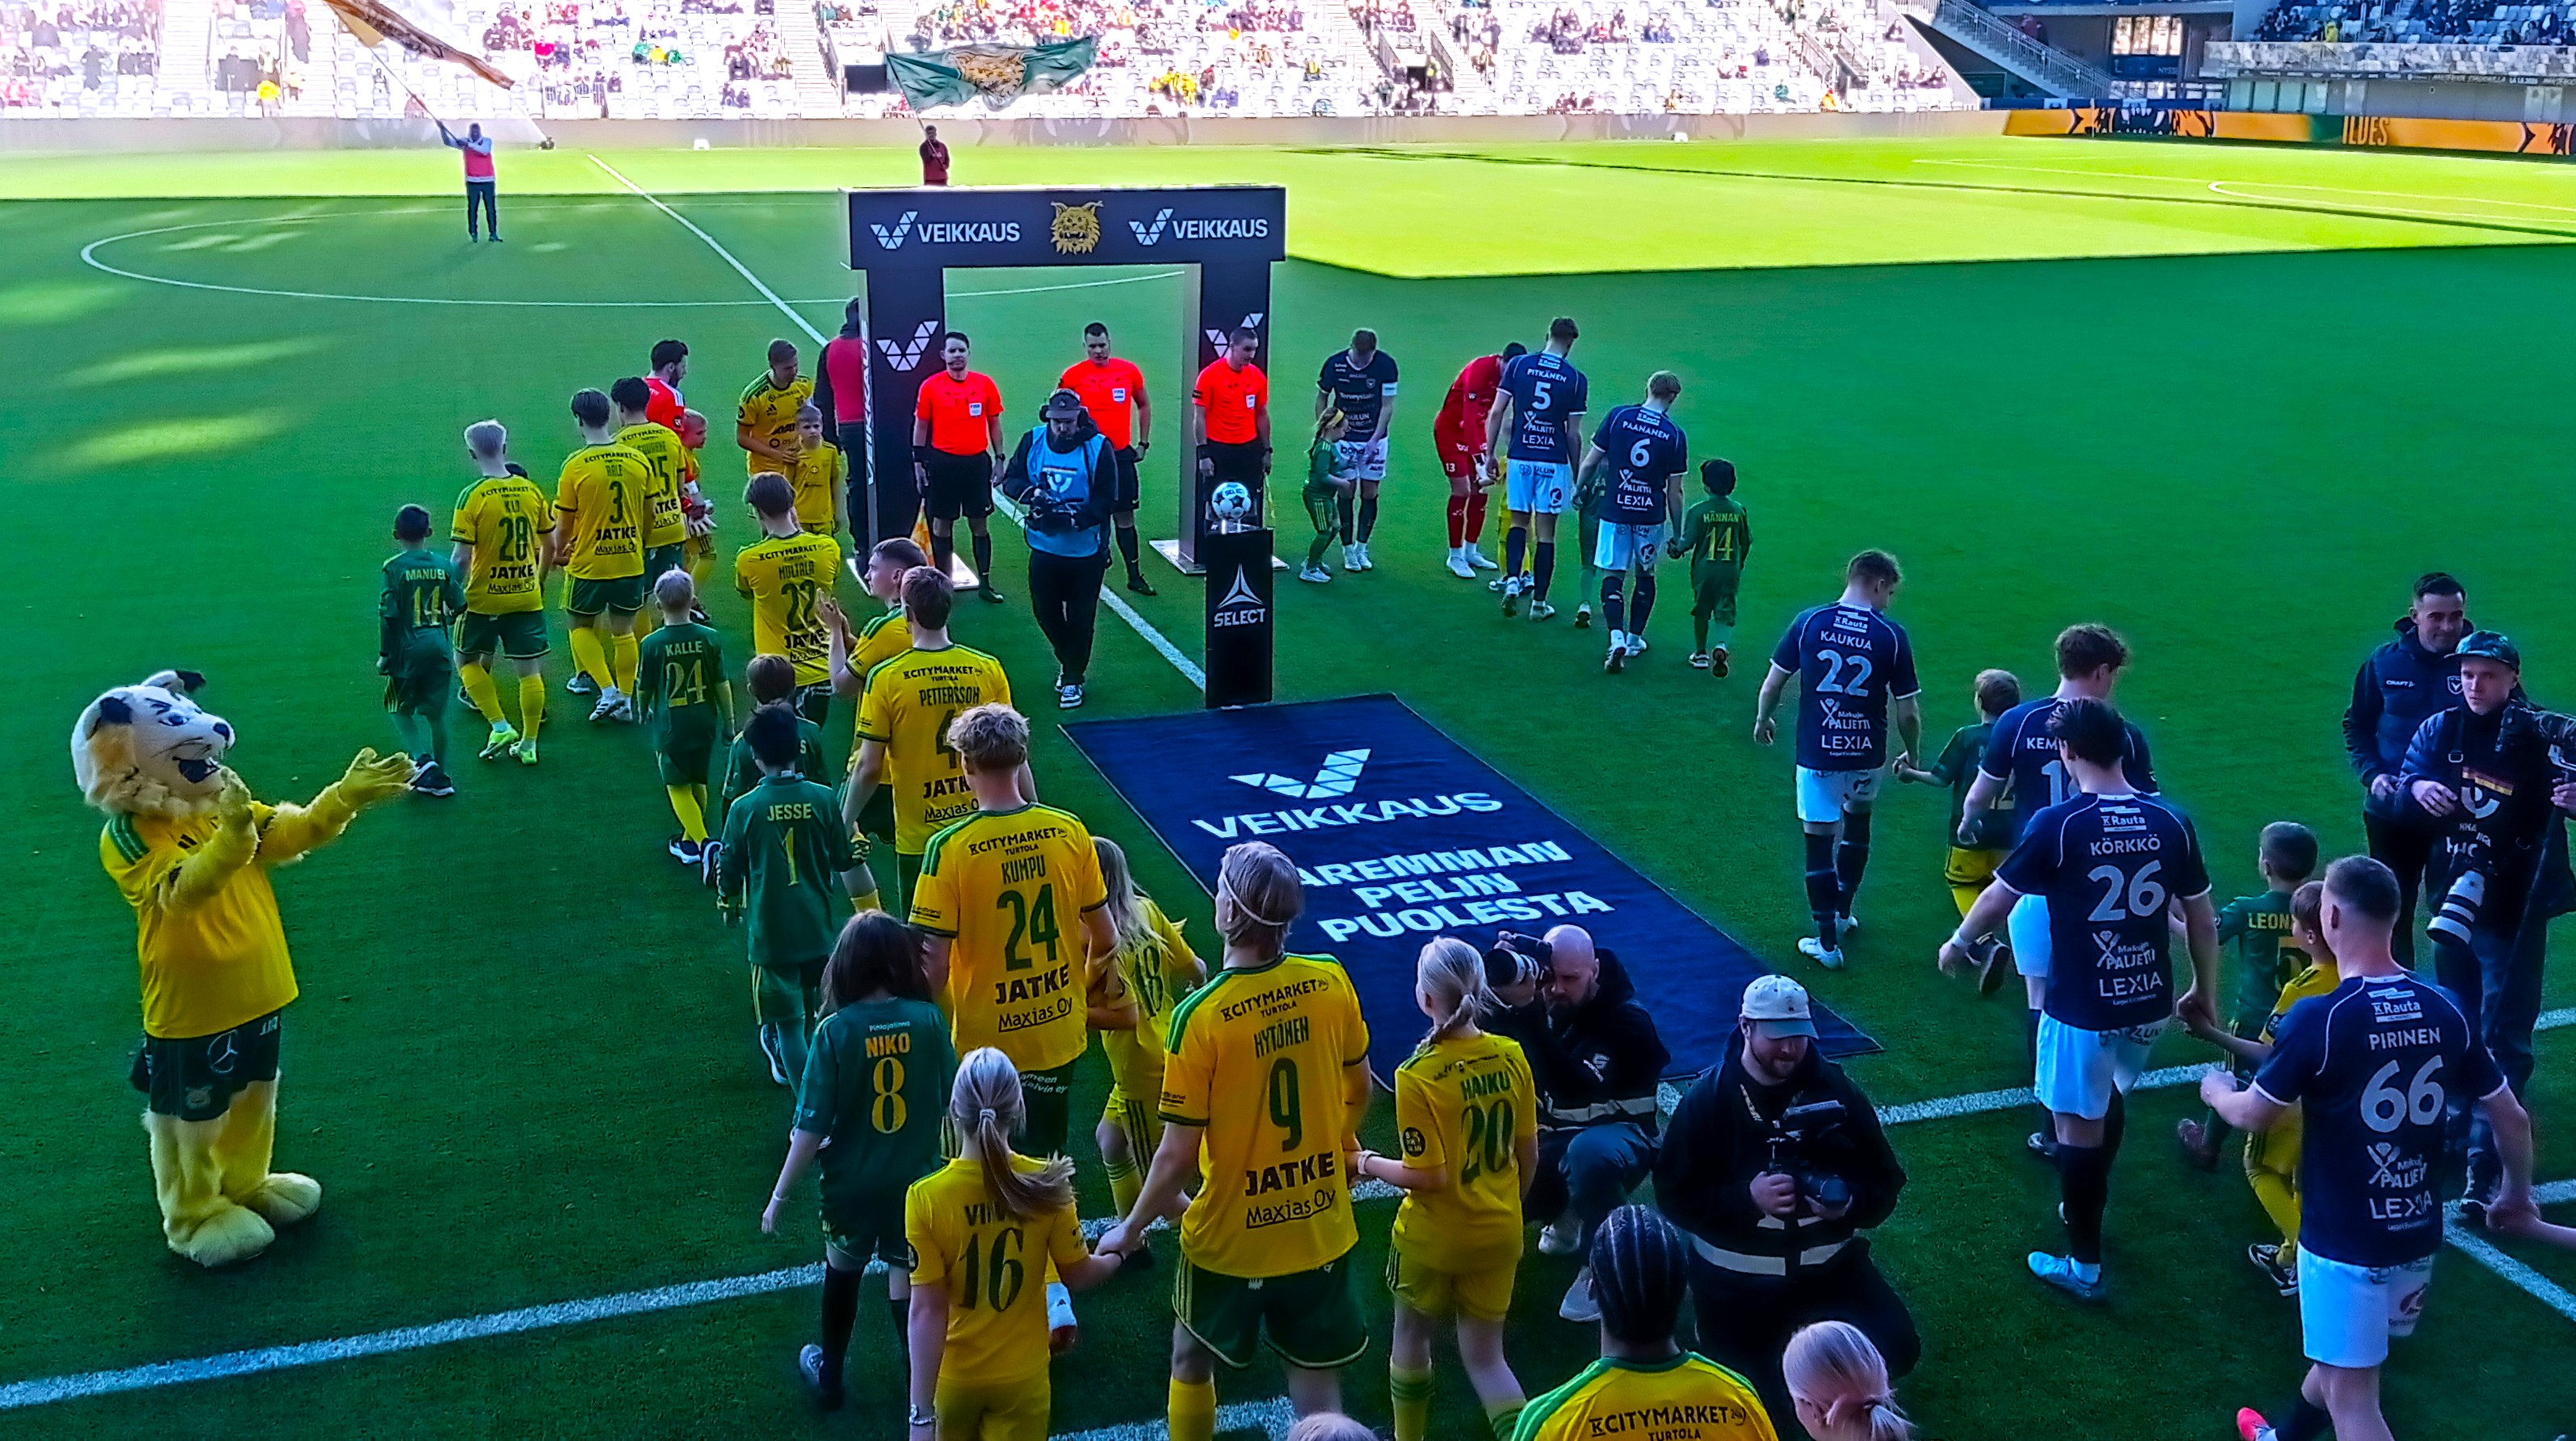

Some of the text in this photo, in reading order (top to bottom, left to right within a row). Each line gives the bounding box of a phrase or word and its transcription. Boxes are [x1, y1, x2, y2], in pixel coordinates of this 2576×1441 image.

[917, 222, 1021, 242] VEIKKAUS
[1172, 219, 1269, 239] VEIKKAUS
[1527, 368, 1567, 383] PITKÄNEN
[1531, 381, 1552, 410] 5
[1522, 434, 1555, 446] LEXIA
[1622, 421, 1670, 441] PAANANEN
[1630, 438, 1651, 467] 6
[1445, 463, 1456, 473] 13
[609, 480, 623, 524] 3
[1225, 488, 1244, 496] SELECT
[1617, 493, 1654, 507] LEXIA
[498, 516, 528, 562] 28
[595, 526, 636, 541] JATKE
[1705, 526, 1734, 561] 14
[489, 564, 535, 580] JATKE
[778, 560, 815, 580] MULTALA
[411, 585, 442, 627] 14
[781, 579, 818, 632] 22
[1214, 609, 1266, 628] SELECT
[665, 640, 703, 657] KALLE
[1820, 630, 1873, 651] KAUKUA
[665, 659, 707, 708] 24
[1815, 649, 1873, 697] 22
[2385, 678, 2410, 687] CRAFT
[918, 686, 980, 707] PETTERSSON
[1821, 734, 1873, 750] LEXIA
[923, 776, 971, 800] JATK
[766, 802, 812, 822] JESSE
[925, 803, 969, 823] Maxjas
[1191, 791, 1504, 840] VEIKKAUS
[781, 827, 799, 886] 1
[1005, 844, 1039, 856] TURTOLA
[2090, 833, 2161, 857] KÖRKKÖ
[1001, 855, 1047, 884] KUMPU
[1297, 840, 1573, 888] AREMMAN
[1350, 872, 1522, 909] PELIN
[2087, 859, 2167, 922] 26
[996, 883, 1060, 971] 24
[1316, 890, 1615, 944] PUOLESTA
[2247, 912, 2293, 929] LEON
[2106, 948, 2156, 970] PALJETTI
[996, 964, 1070, 1004] JATKE
[2099, 971, 2163, 997] LEXIA
[998, 997, 1072, 1033] Maxjas Oy
[1261, 1000, 1298, 1018] TURTOLA
[865, 1033, 911, 1058] NIKO
[1253, 1016, 1310, 1058] HYTÖNEN
[2368, 1026, 2441, 1050] PIRINEN
[871, 1056, 907, 1134] 8
[1460, 1070, 1512, 1102] HAIKU
[2360, 1054, 2445, 1133] 66
[1269, 1058, 1303, 1153] 9
[1460, 1099, 1515, 1185] 20
[1244, 1151, 1336, 1197] JATKE
[1246, 1189, 1336, 1229] Maxjas Oy
[2368, 1189, 2433, 1220] LEXIA
[958, 1227, 1024, 1313] 16
[1647, 1428, 1702, 1441] TURTOLA
